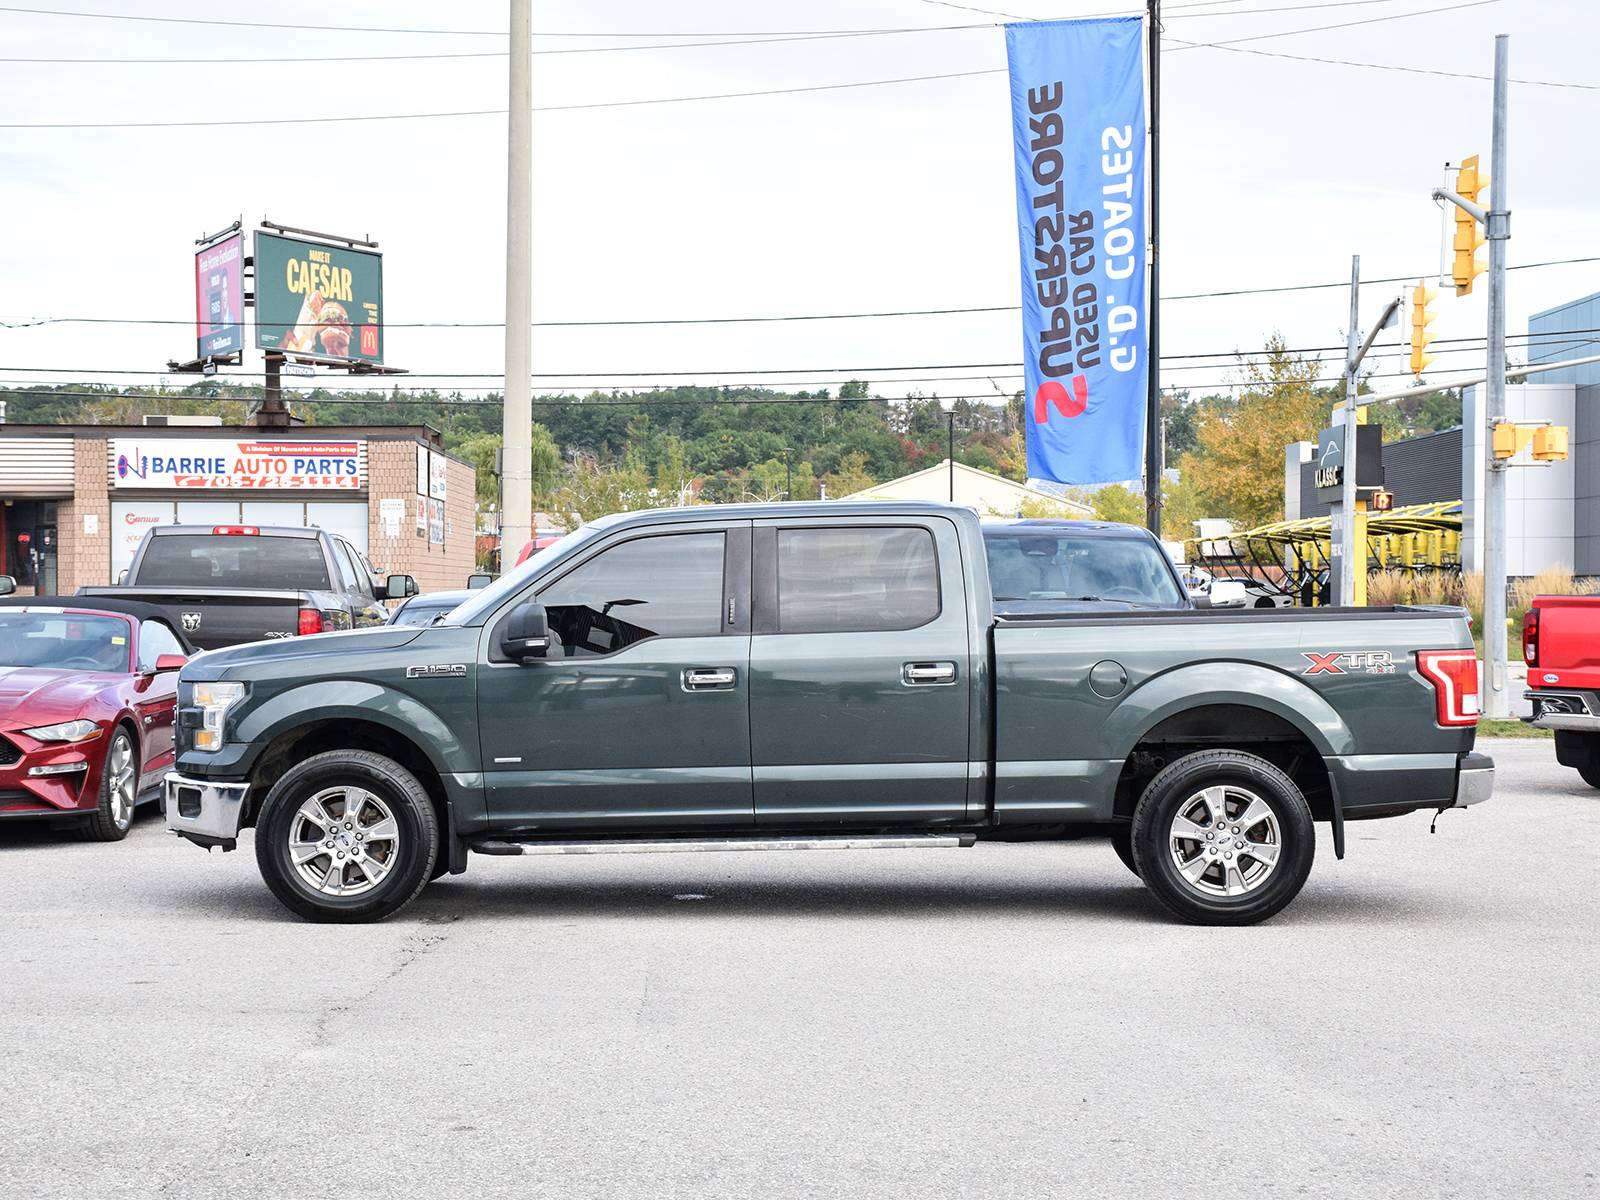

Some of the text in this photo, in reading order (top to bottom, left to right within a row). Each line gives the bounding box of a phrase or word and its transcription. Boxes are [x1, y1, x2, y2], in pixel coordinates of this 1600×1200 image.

[286, 257, 353, 302] CAESAR
[152, 457, 357, 475] BARRIE AUTO PARTS
[1301, 650, 1396, 675] XTR
